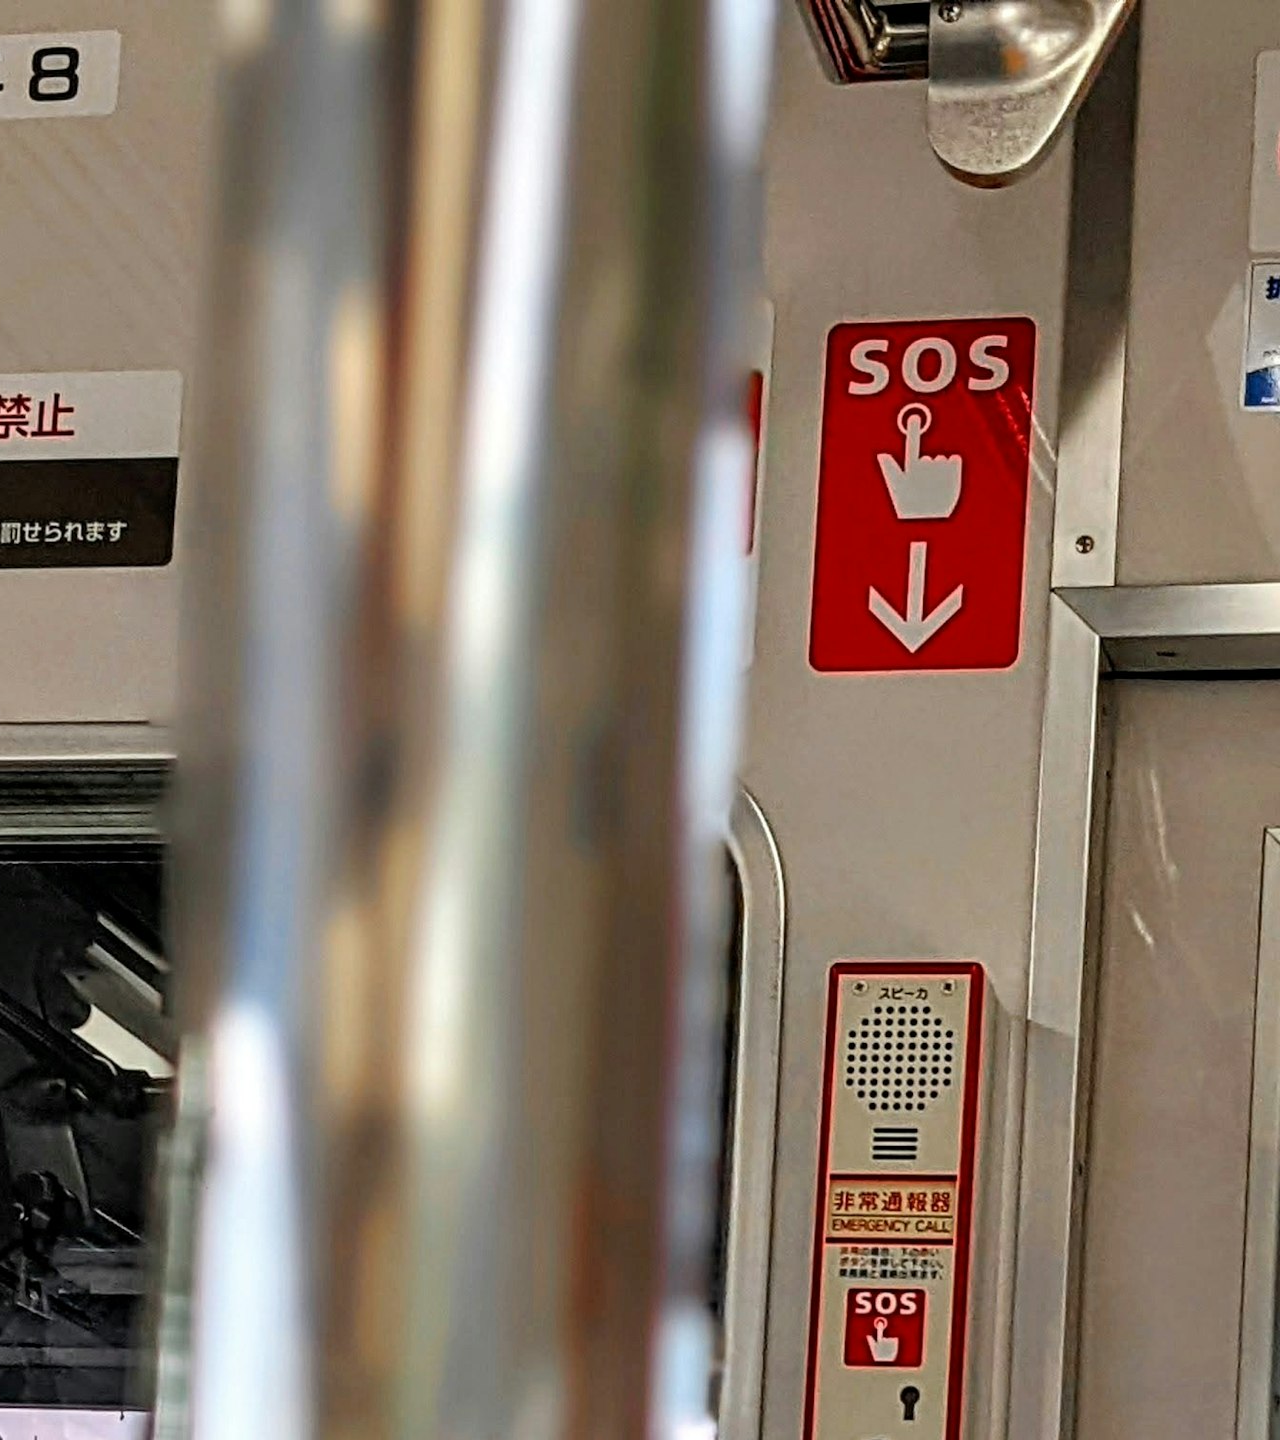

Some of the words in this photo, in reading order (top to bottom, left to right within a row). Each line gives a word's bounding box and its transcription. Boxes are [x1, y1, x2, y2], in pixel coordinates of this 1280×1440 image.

[848, 335, 1010, 396] SOS
[878, 987, 929, 1001] スピーカ
[834, 1190, 951, 1213] 非常通報器
[832, 1218, 910, 1232] EMERGENCY
[915, 1219, 951, 1233] CALL
[855, 1292, 917, 1314] SOS
